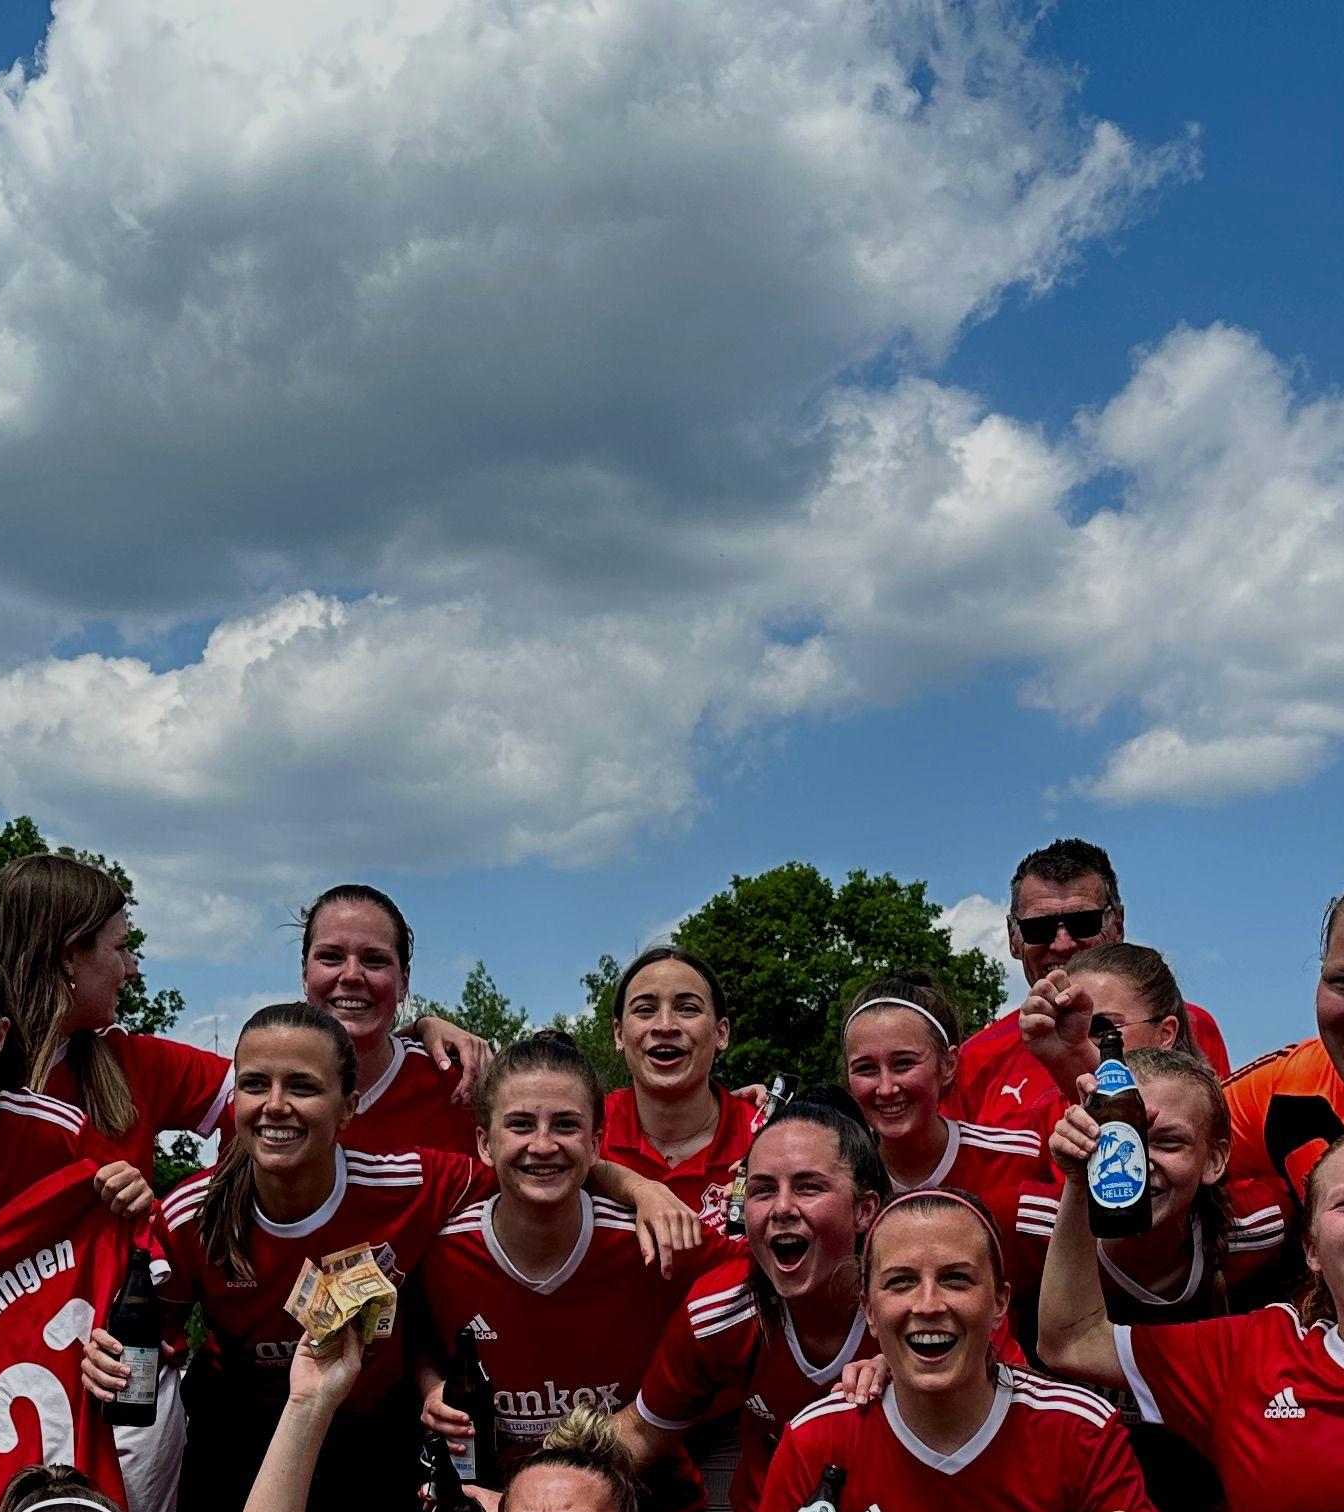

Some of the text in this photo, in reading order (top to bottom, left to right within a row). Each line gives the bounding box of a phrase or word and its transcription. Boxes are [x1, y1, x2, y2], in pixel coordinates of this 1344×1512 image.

[1102, 1188, 1134, 1200] HELLES
[377, 1317, 391, 1331] 50
[475, 1331, 498, 1340] idas
[1263, 1405, 1306, 1419] adidas
